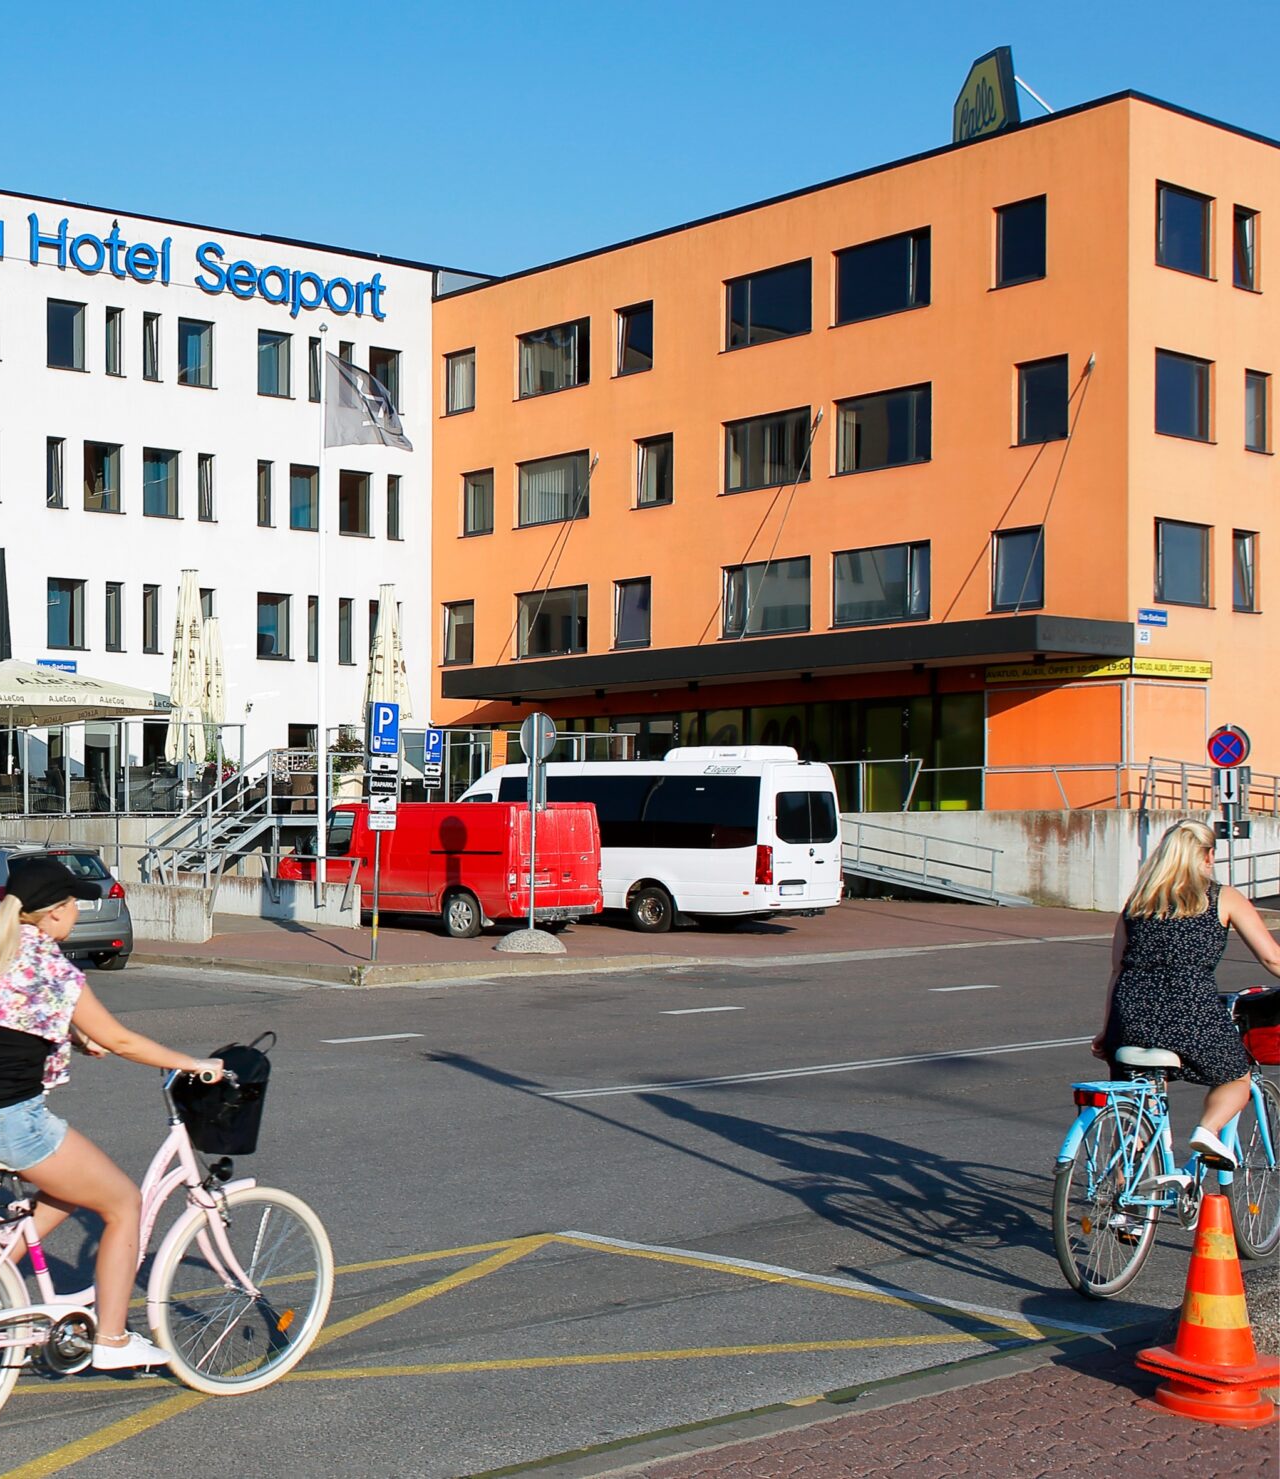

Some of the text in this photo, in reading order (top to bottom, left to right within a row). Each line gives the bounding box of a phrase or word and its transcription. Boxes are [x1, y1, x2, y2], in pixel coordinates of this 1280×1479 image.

[27, 212, 172, 286] Hotel
[195, 241, 386, 320] Seaport
[1106, 662, 1130, 671] 19:00
[378, 706, 394, 734] P
[428, 732, 440, 750] P
[703, 765, 742, 775] Elegant
